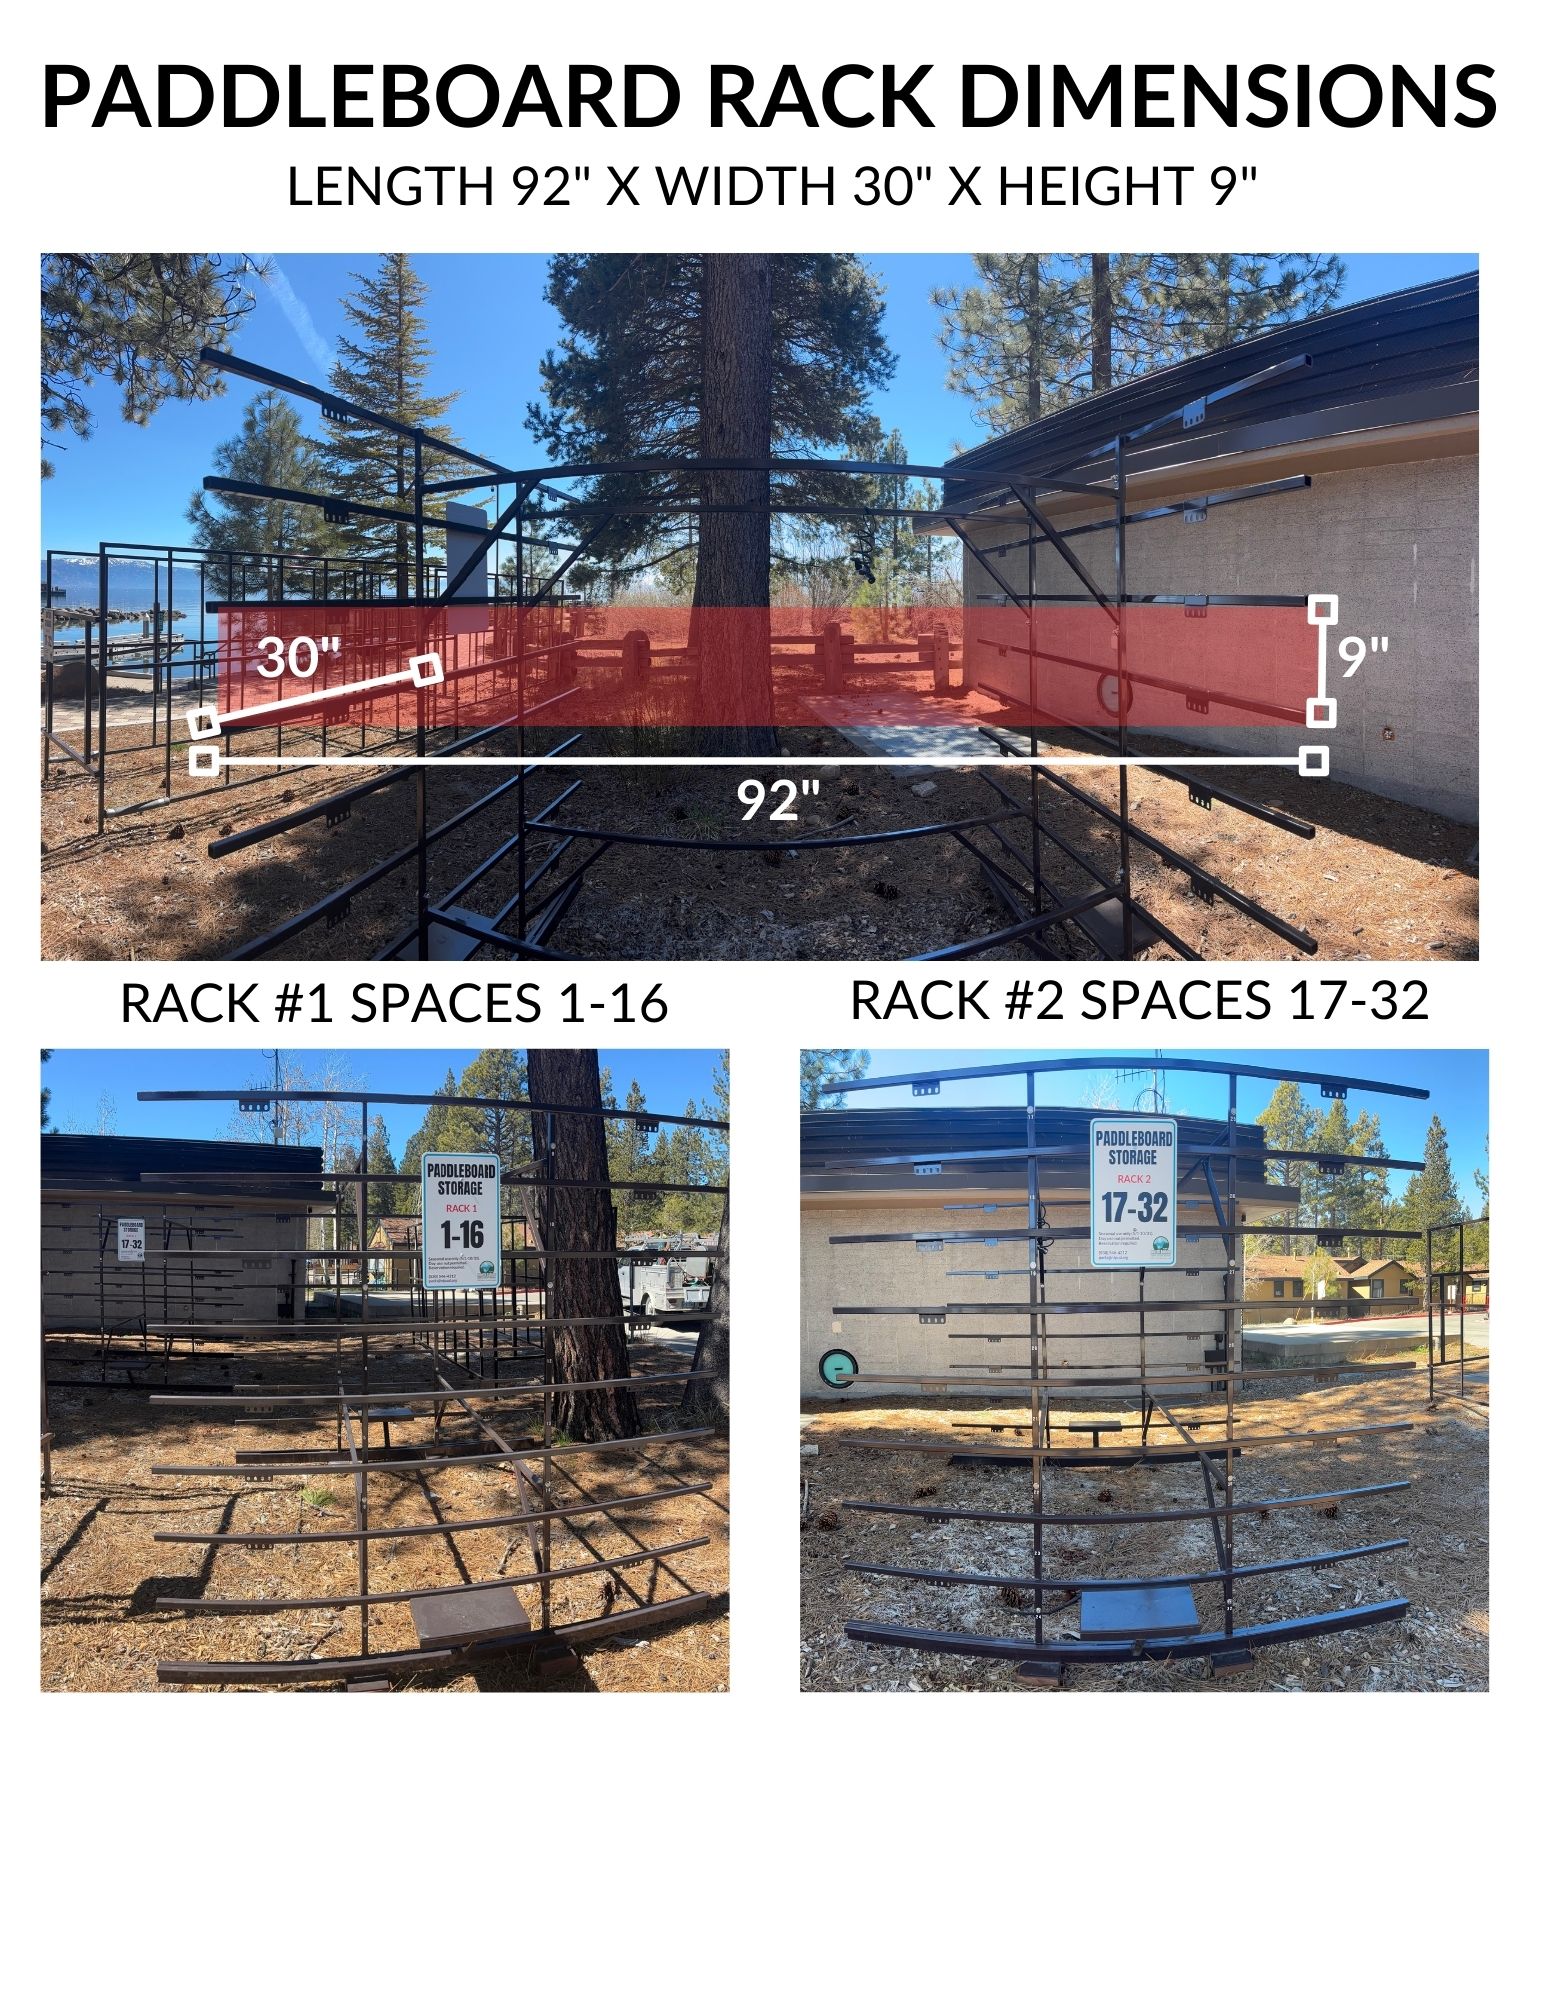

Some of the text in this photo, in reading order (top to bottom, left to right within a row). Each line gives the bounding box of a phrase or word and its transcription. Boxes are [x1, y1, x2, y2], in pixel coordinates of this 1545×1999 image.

[1096, 1131, 1172, 1146] PADDLEBOARD
[1109, 1150, 1157, 1165] STORAGE
[1117, 1175, 1151, 1183] RACK 2
[438, 1181, 483, 1195] STORAGE
[446, 1204, 478, 1212] RACK 1
[1102, 1192, 1168, 1222] 17-32
[441, 1220, 484, 1249] 1-16
[122, 1240, 142, 1248] 17-32
